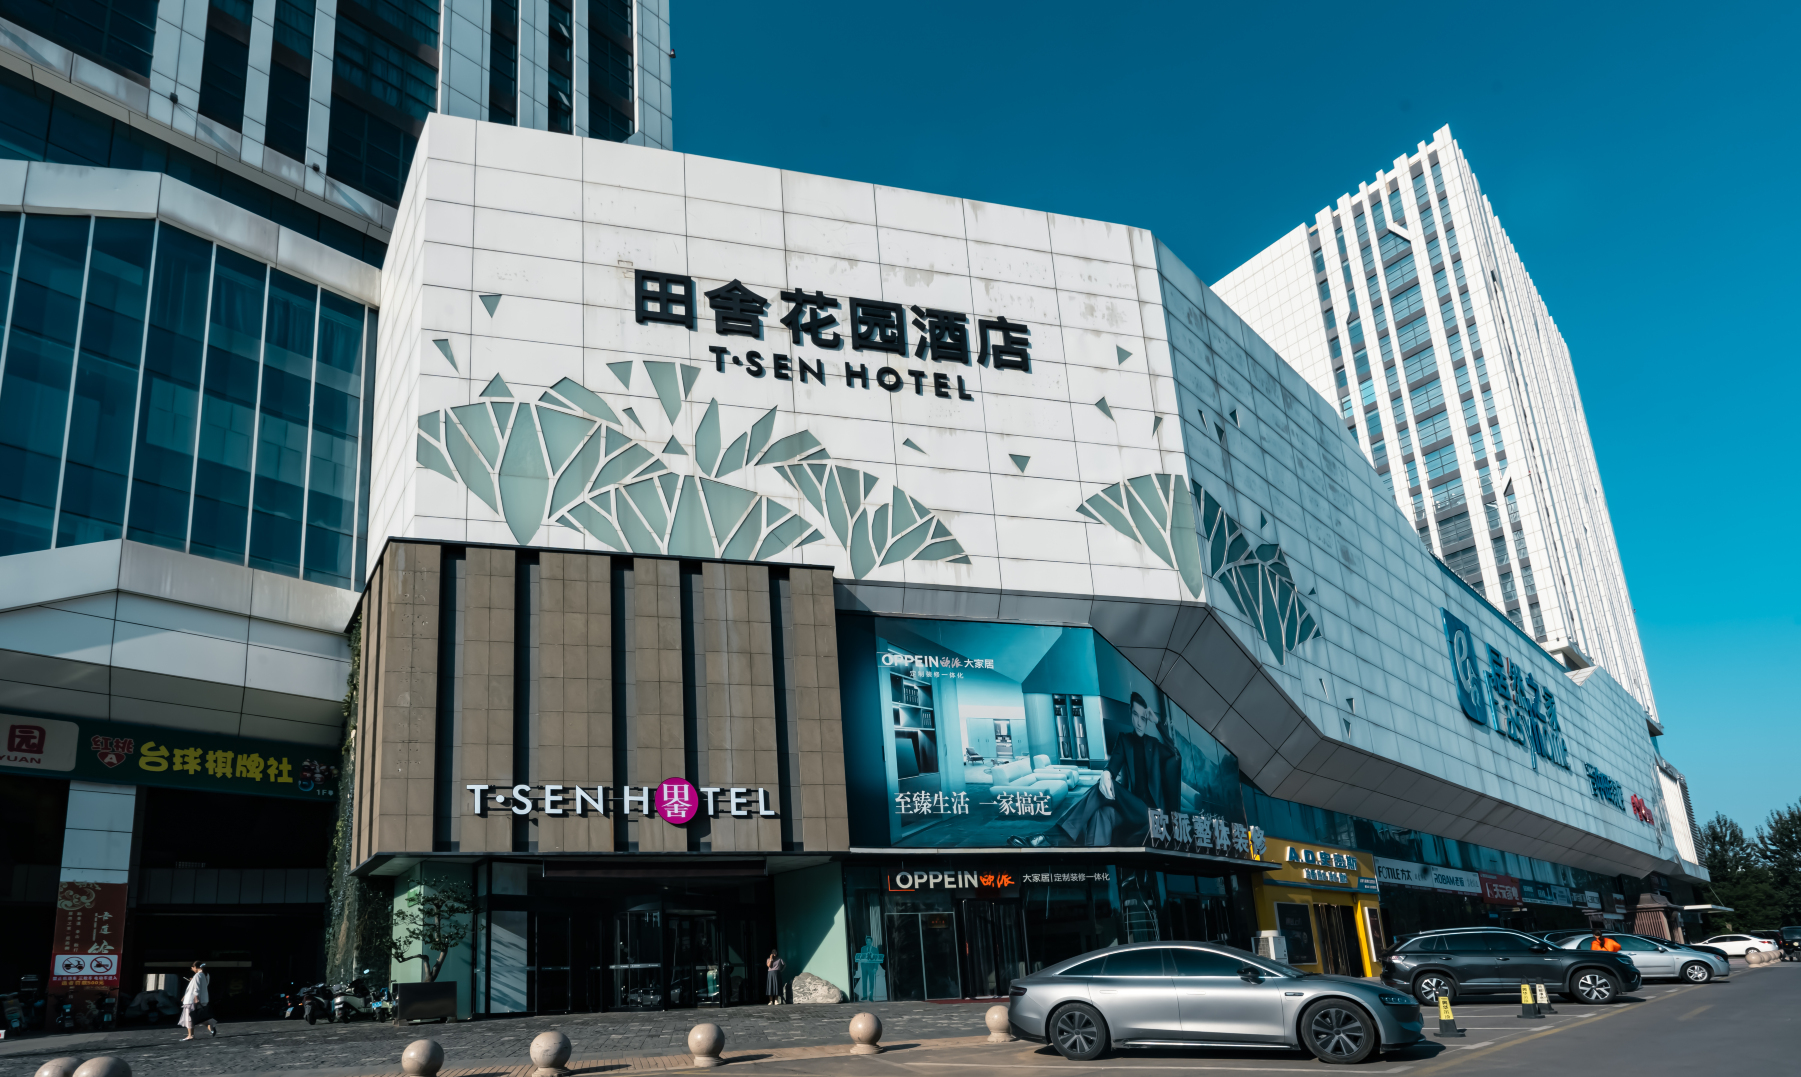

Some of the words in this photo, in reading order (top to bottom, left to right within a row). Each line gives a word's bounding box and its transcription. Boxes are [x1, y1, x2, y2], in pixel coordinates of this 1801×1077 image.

[634, 268, 1031, 374] 田舍花园酒店
[845, 361, 975, 401] HOTEL
[881, 653, 939, 668] OPPEIN
[964, 658, 994, 669] 大家居
[909, 671, 964, 679] 定制装修一体化
[90, 734, 134, 755] 红桃
[138, 741, 294, 784] 台球棋牌社
[894, 791, 970, 815] 至臻生活
[979, 791, 1052, 816] 一家搞定
[1148, 808, 1267, 856] 欧派整体装修
[896, 870, 979, 889] OPPEIN
